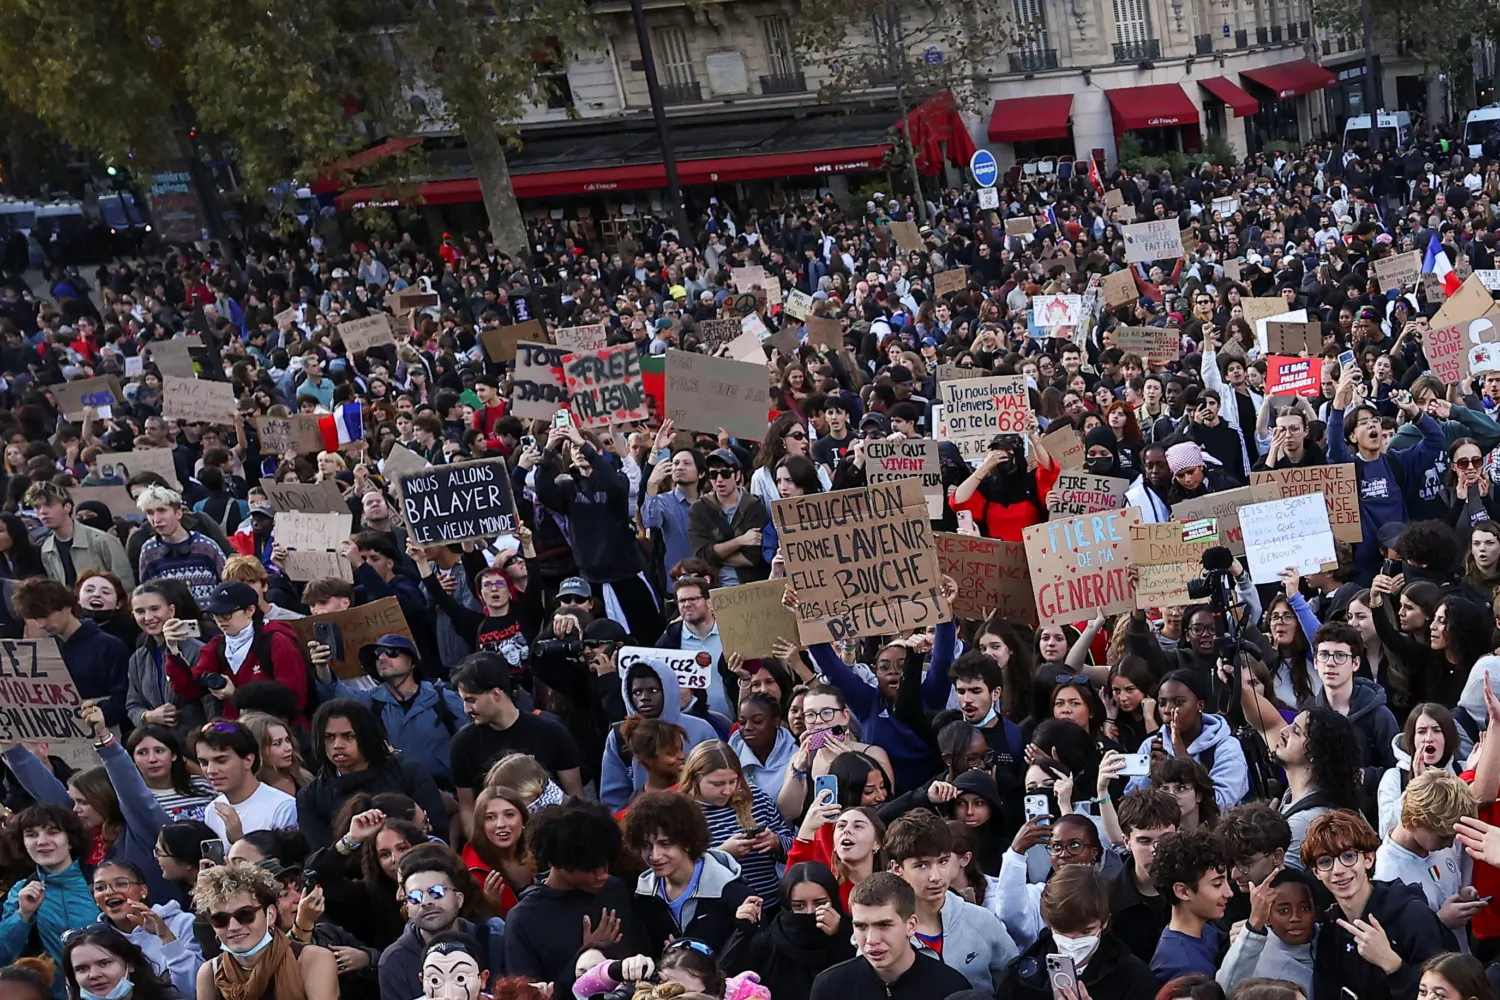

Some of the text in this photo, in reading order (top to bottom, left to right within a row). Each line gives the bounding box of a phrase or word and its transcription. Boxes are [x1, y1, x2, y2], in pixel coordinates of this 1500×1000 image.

[1428, 326, 1461, 346] SOIS
[1430, 342, 1464, 360] JEUNE
[569, 354, 641, 384] FREE
[1279, 364, 1290, 375] LE
[1433, 360, 1460, 375] TAIS
[1280, 371, 1308, 383] PAS LES
[1440, 370, 1460, 385] TOI
[948, 384, 965, 401] Tu
[966, 387, 988, 399] nous
[946, 401, 955, 414] à
[950, 410, 1026, 433] on te la 68
[867, 443, 927, 459] CEUX QUI
[879, 458, 925, 471] VIVENT
[407, 465, 494, 496] NOUS ALLONS
[1059, 475, 1111, 493] FIRE IS
[1280, 467, 1344, 484] VIOLENCE
[1281, 479, 1357, 498] PEUPLE N'EST
[405, 484, 502, 525] BALAYER
[1061, 489, 1117, 508] CATCHING
[1283, 496, 1314, 512] SONT
[775, 485, 905, 535] L'ÉDUCATION
[1275, 510, 1298, 521] QUE
[414, 524, 433, 543] LE
[478, 513, 516, 534] MONDE
[1277, 519, 1297, 533] QUE
[785, 538, 831, 565] FORME
[1253, 534, 1307, 552] SOMMES
[1075, 548, 1115, 568] DE MA
[791, 552, 928, 601] ELLE BOUCHE
[961, 576, 985, 590] OR
[987, 591, 1010, 605] MY
[799, 602, 824, 621] PAS
[825, 599, 851, 618] LES
